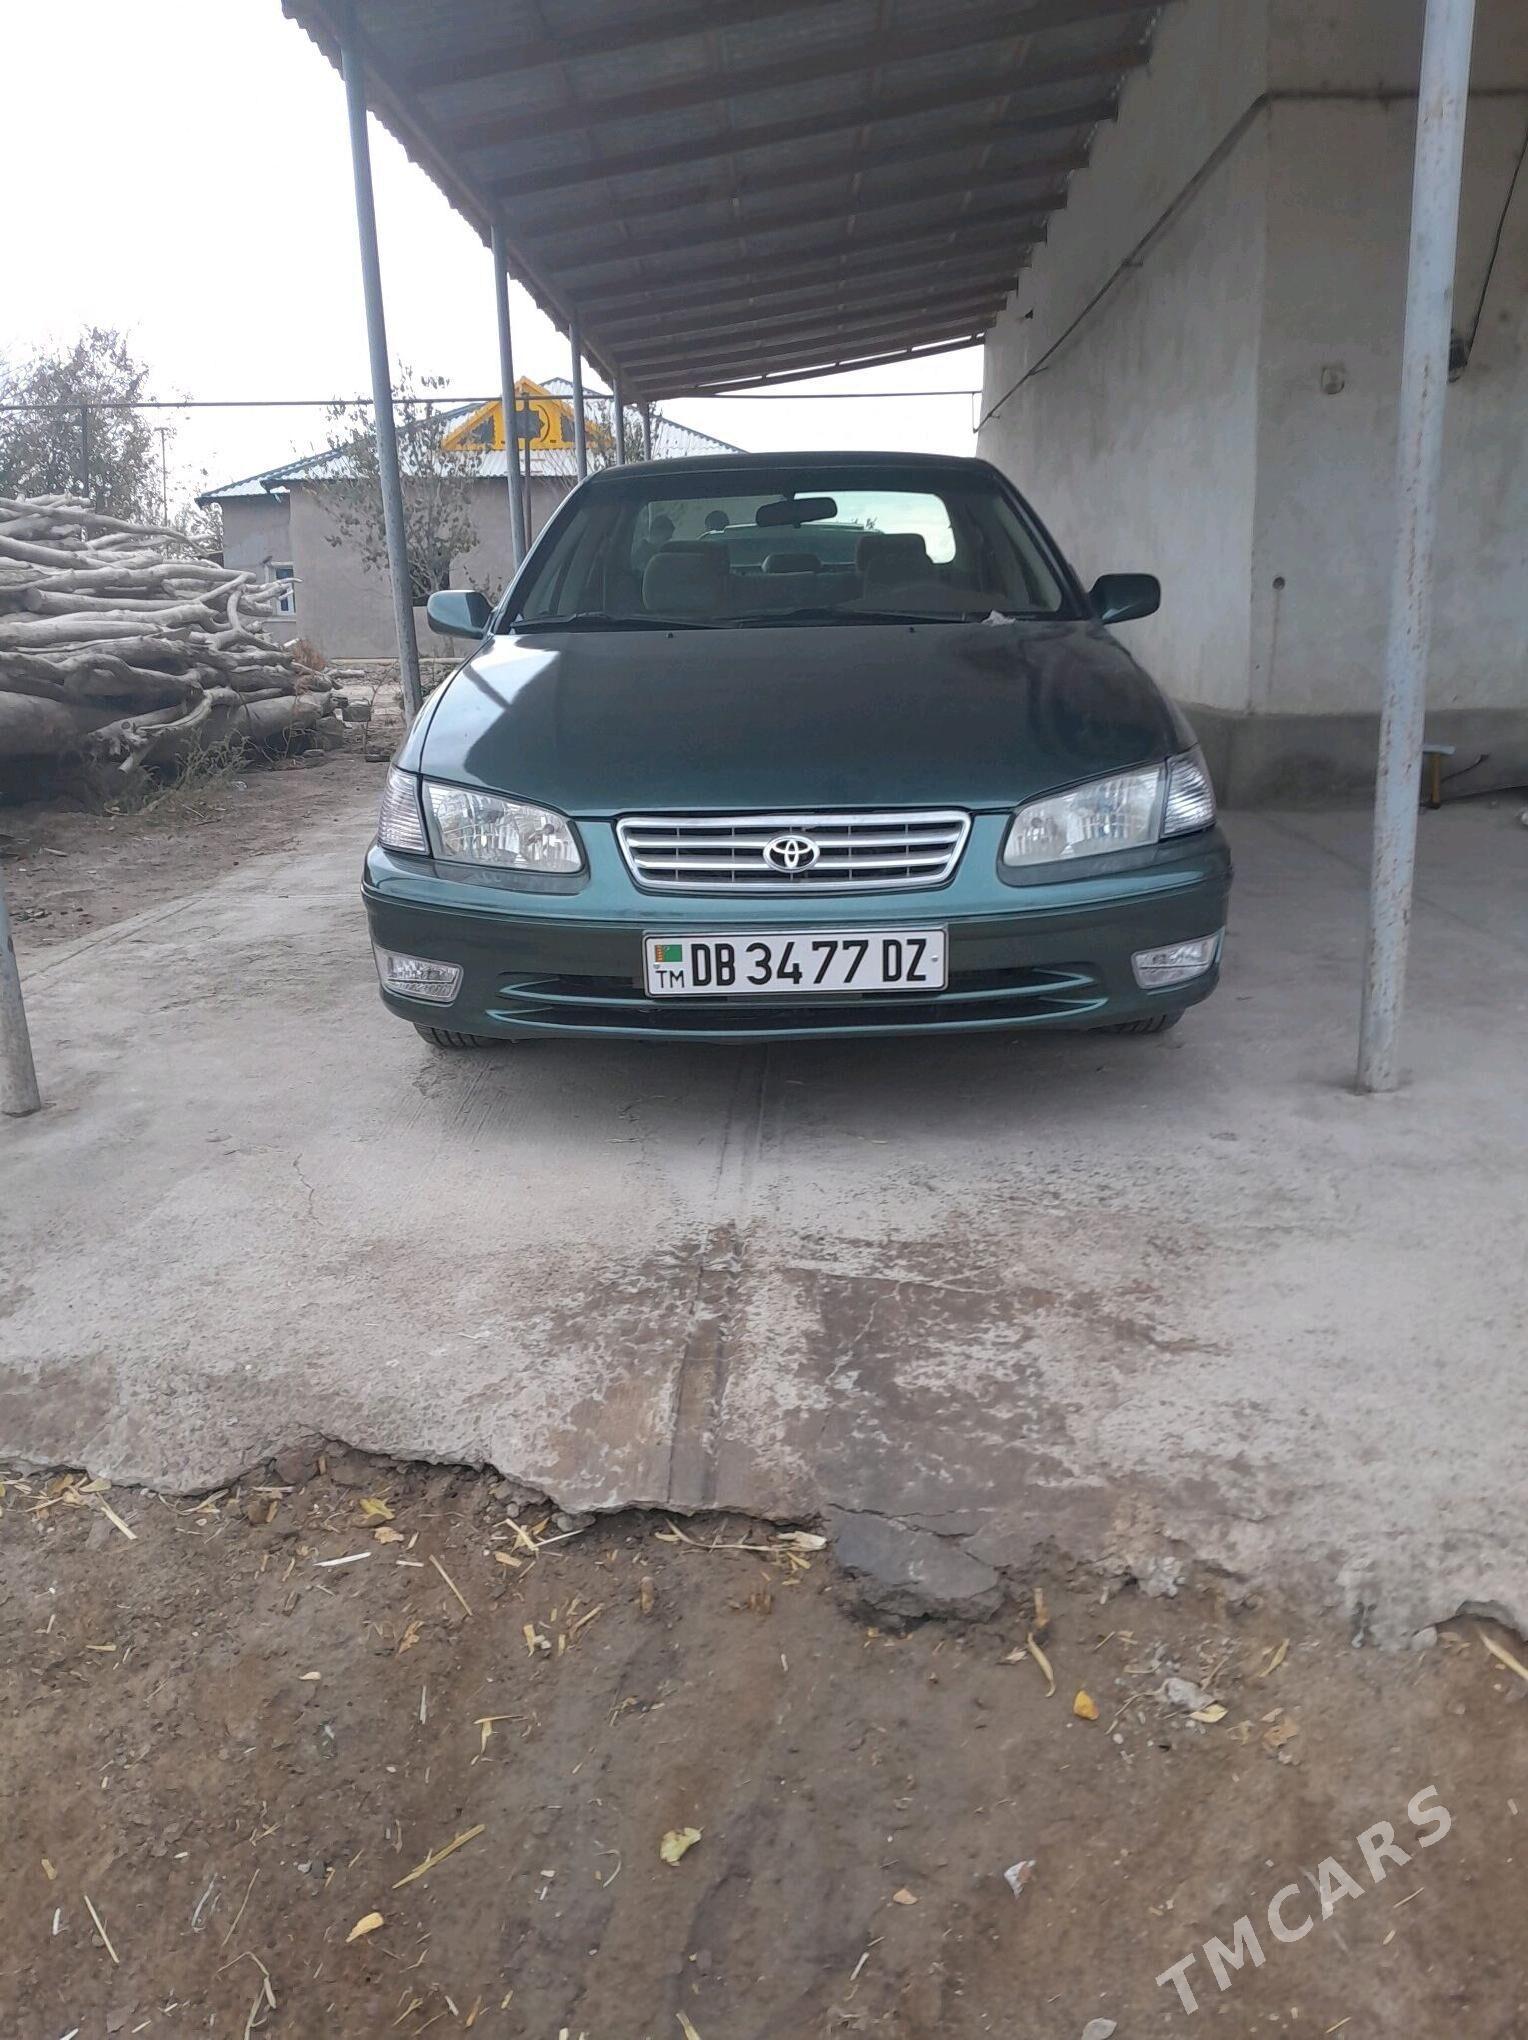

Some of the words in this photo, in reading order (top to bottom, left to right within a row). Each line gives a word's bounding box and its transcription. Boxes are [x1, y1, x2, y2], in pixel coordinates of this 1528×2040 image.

[656, 970, 685, 988] TM
[691, 943, 736, 987] DB
[746, 940, 869, 985] 3477
[882, 938, 927, 983] DZ
